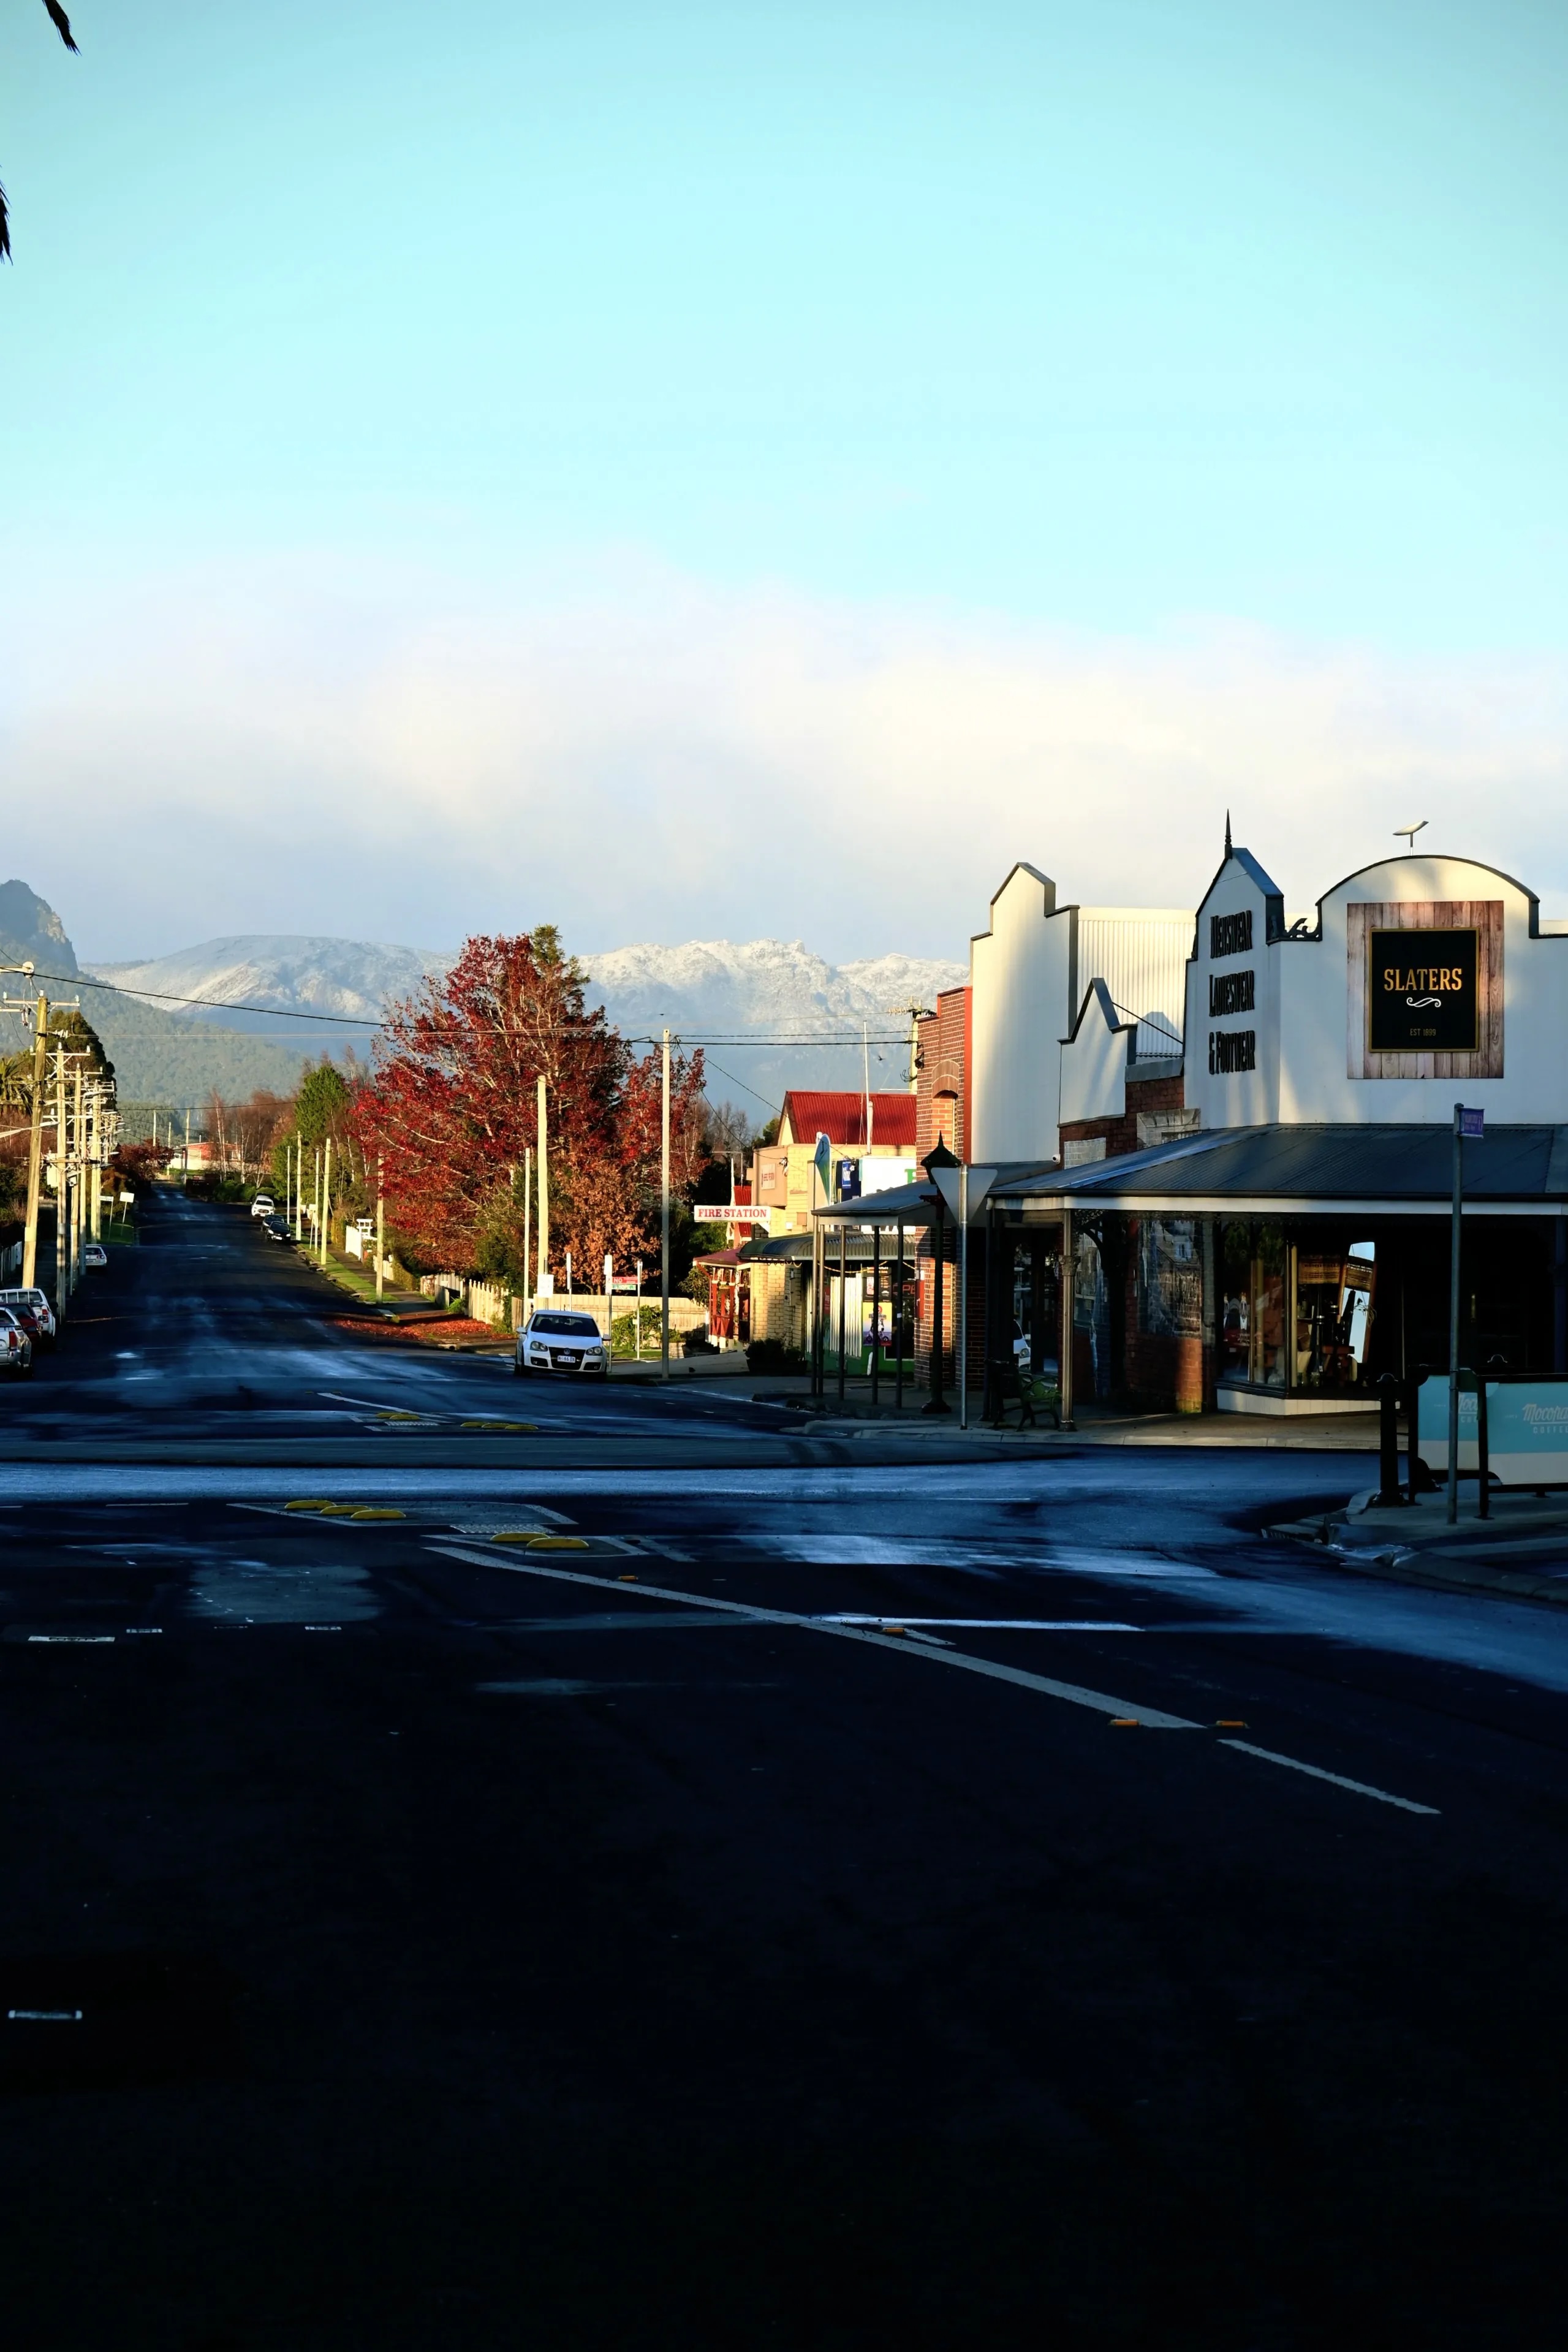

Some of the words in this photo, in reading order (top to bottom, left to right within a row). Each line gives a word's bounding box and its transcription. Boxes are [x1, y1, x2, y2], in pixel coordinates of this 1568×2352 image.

[1384, 968, 1463, 991] SLATERS
[1209, 1031, 1215, 1075] &
[698, 1208, 722, 1218] FIRE
[724, 1208, 767, 1218] STATION
